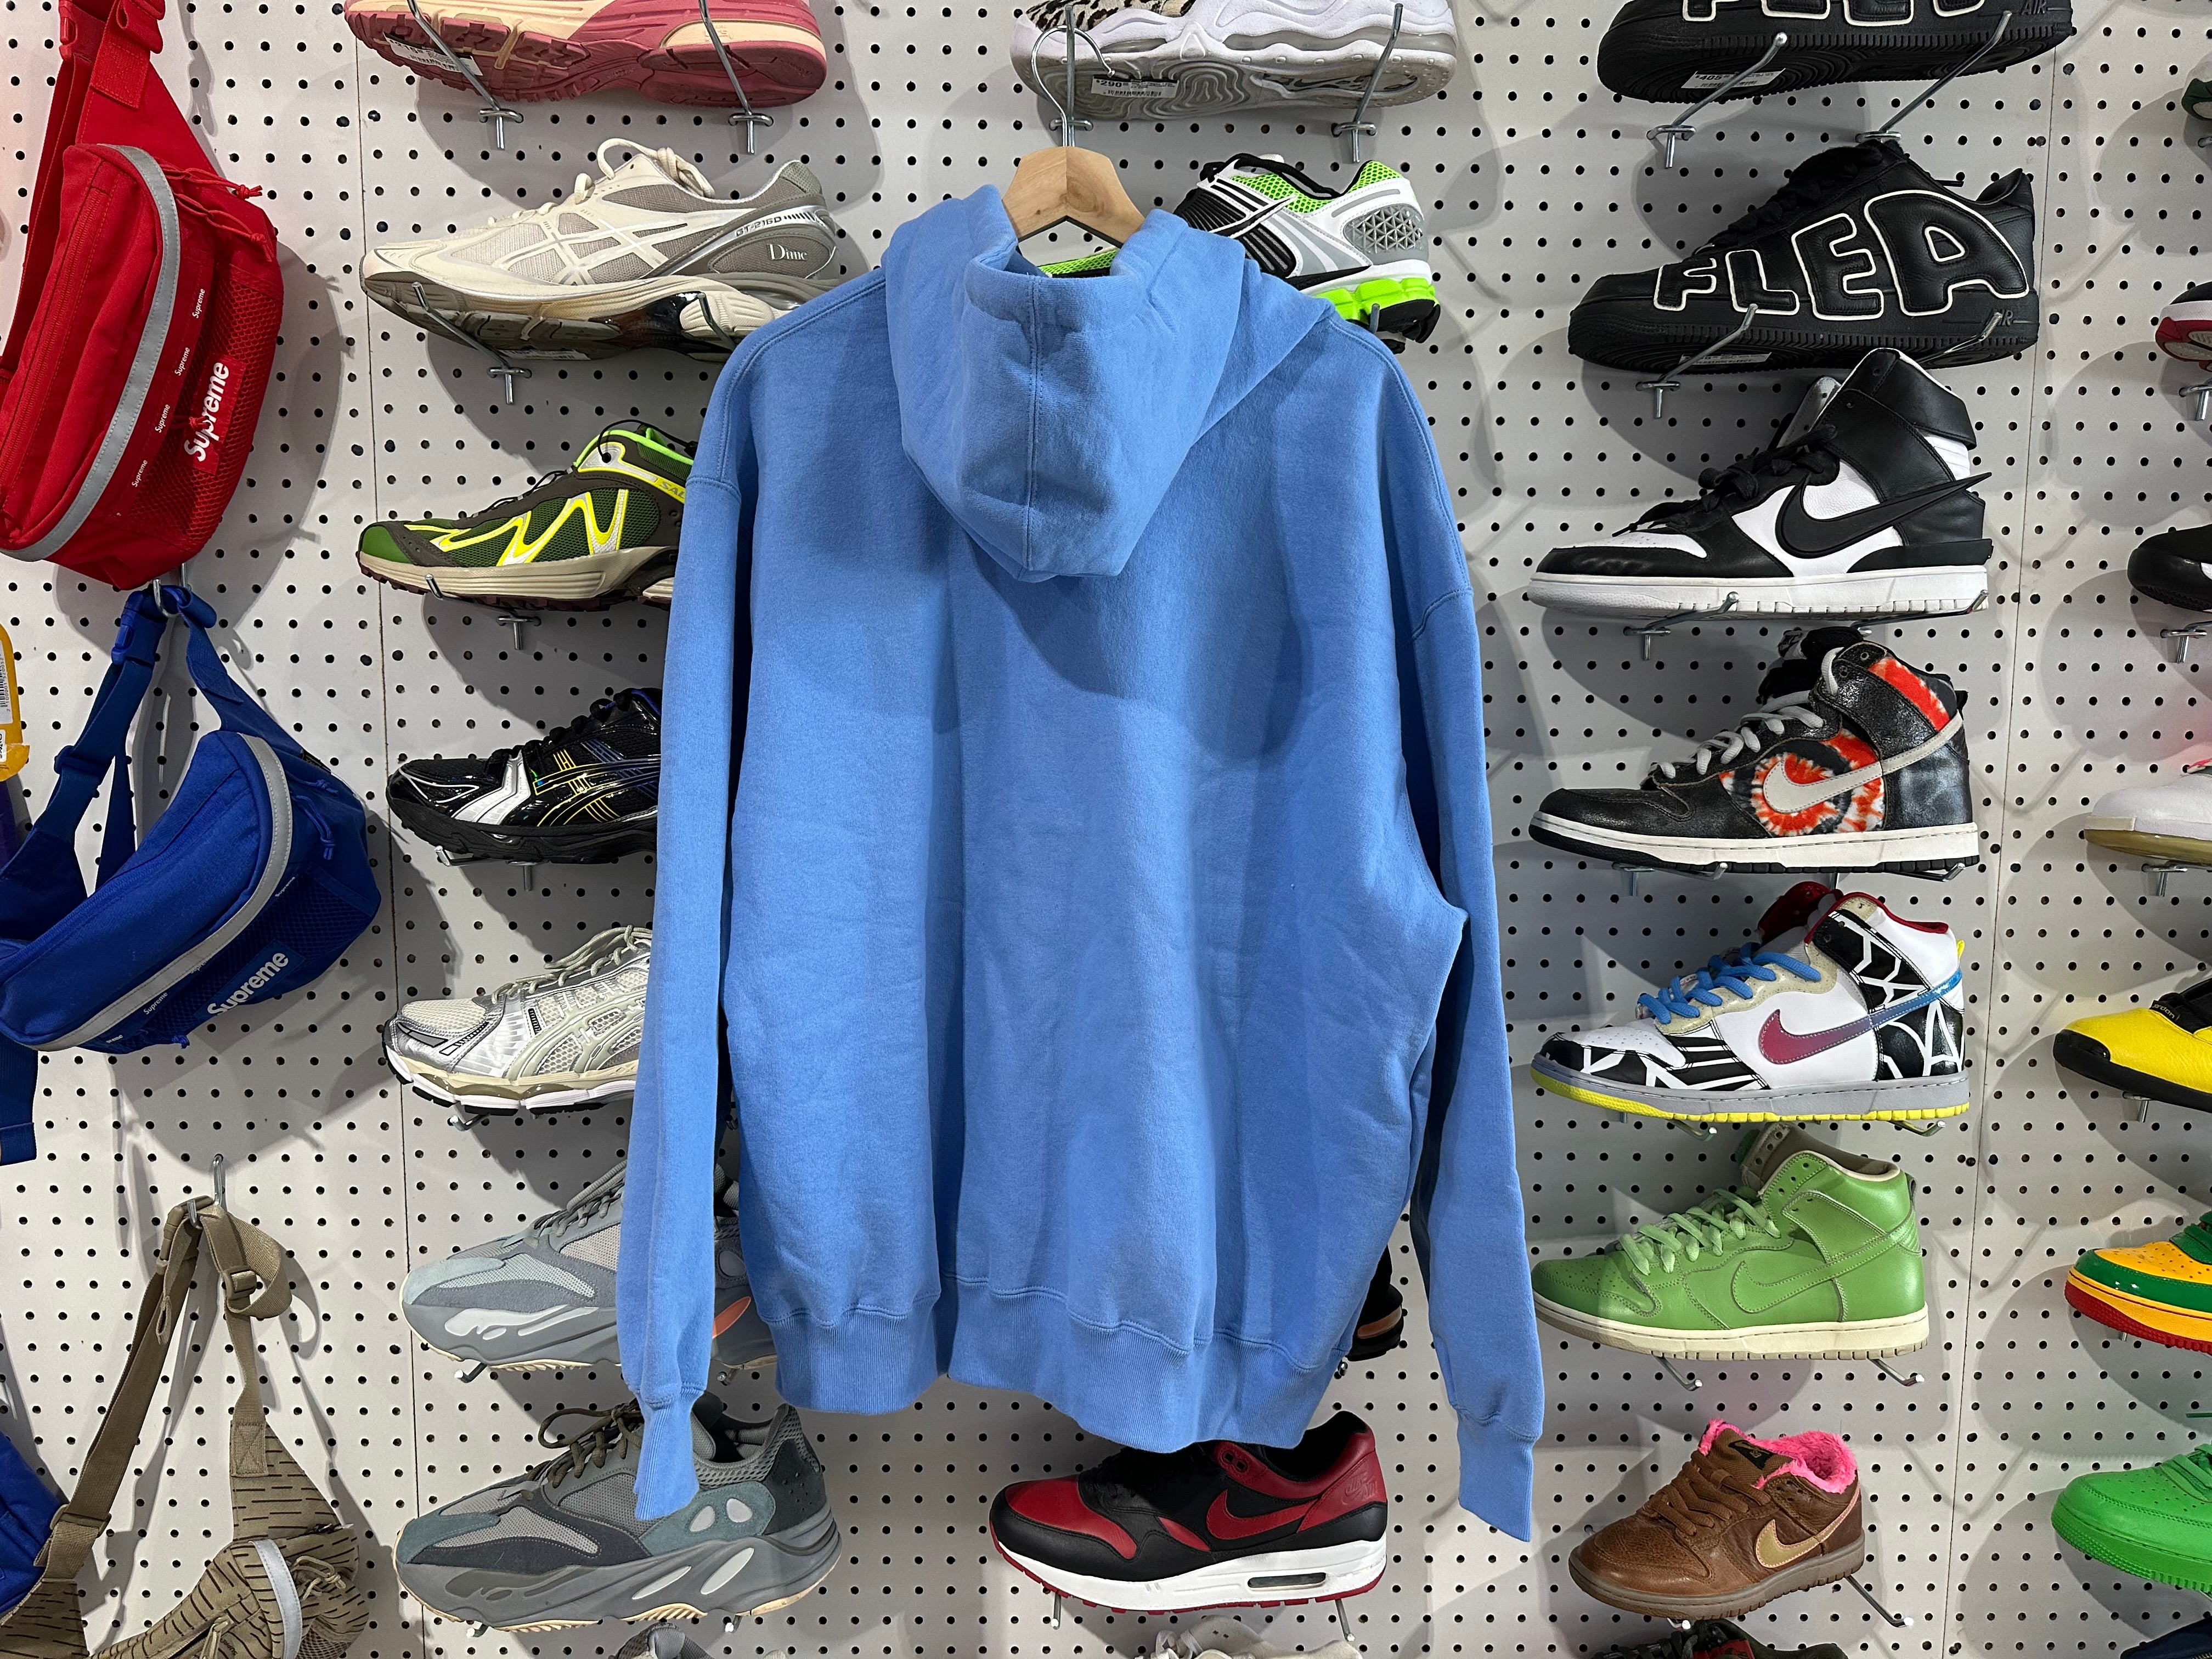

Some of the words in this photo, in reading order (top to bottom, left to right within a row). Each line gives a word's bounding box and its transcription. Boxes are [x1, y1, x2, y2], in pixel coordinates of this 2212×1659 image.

[766, 244, 808, 261] Dime
[1652, 189, 2030, 321] FLEA
[192, 288, 205, 319] Supreme
[174, 347, 190, 376] Supreme
[155, 404, 170, 433] Supreme
[184, 362, 229, 462] Supreme
[132, 459, 148, 487] Supreme
[207, 952, 289, 1015] Supreme
[143, 992, 168, 1015] Supreme
